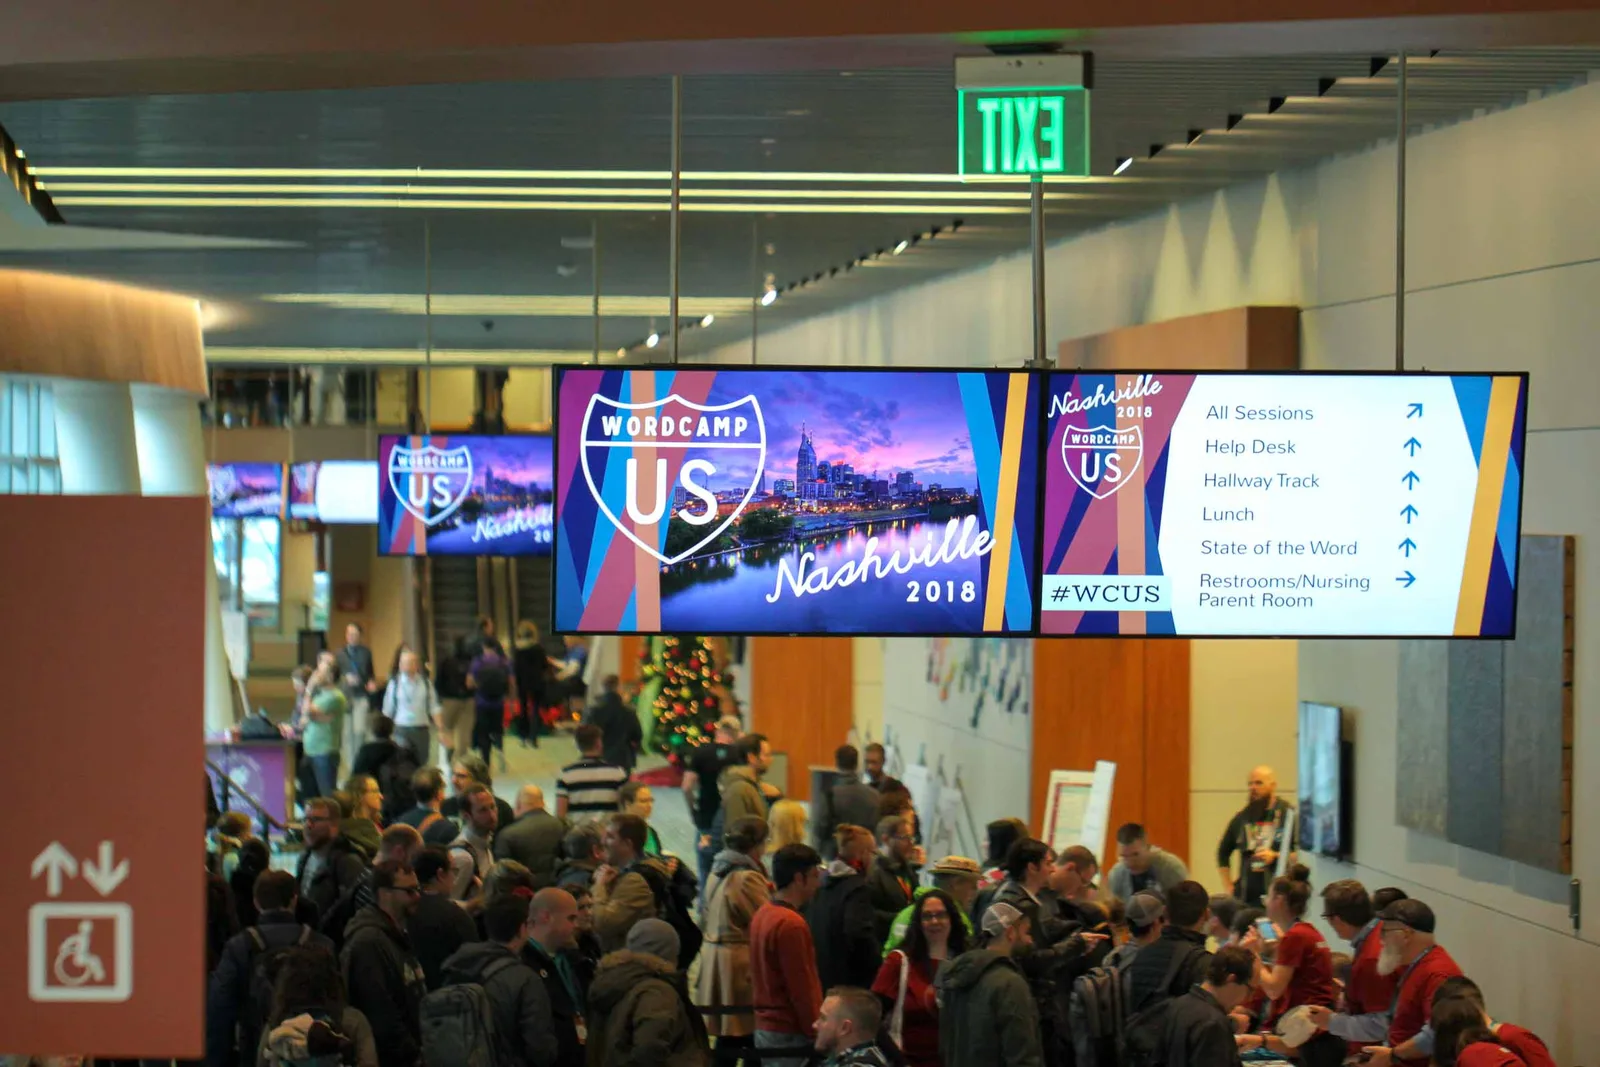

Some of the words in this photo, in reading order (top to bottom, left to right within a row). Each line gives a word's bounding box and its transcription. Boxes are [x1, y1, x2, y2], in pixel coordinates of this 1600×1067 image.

[1047, 374, 1163, 419] Nashville
[1116, 406, 1153, 418] 2018
[1206, 405, 1228, 421] All
[1235, 405, 1314, 421] Sessions
[601, 415, 749, 438] WORDCAMP
[1071, 434, 1136, 445] WORDCAMP
[1205, 439, 1247, 457] Help
[1252, 439, 1297, 456] Desk
[1080, 452, 1122, 483] US
[408, 474, 452, 508] US
[1204, 472, 1274, 491] Hallway
[1276, 473, 1320, 489] Track
[626, 457, 718, 526] US
[1203, 506, 1255, 523] Lunch
[1201, 539, 1248, 556] State
[1253, 539, 1272, 556] of
[1277, 539, 1305, 556] the
[1310, 540, 1358, 556] Word
[766, 513, 997, 604] Nashville
[906, 580, 977, 603] 2018
[1199, 573, 1370, 593] Restrooms/Nursing
[1050, 584, 1160, 603] #WCUS
[1199, 592, 1256, 608] Parent
[1262, 592, 1314, 608] Room
